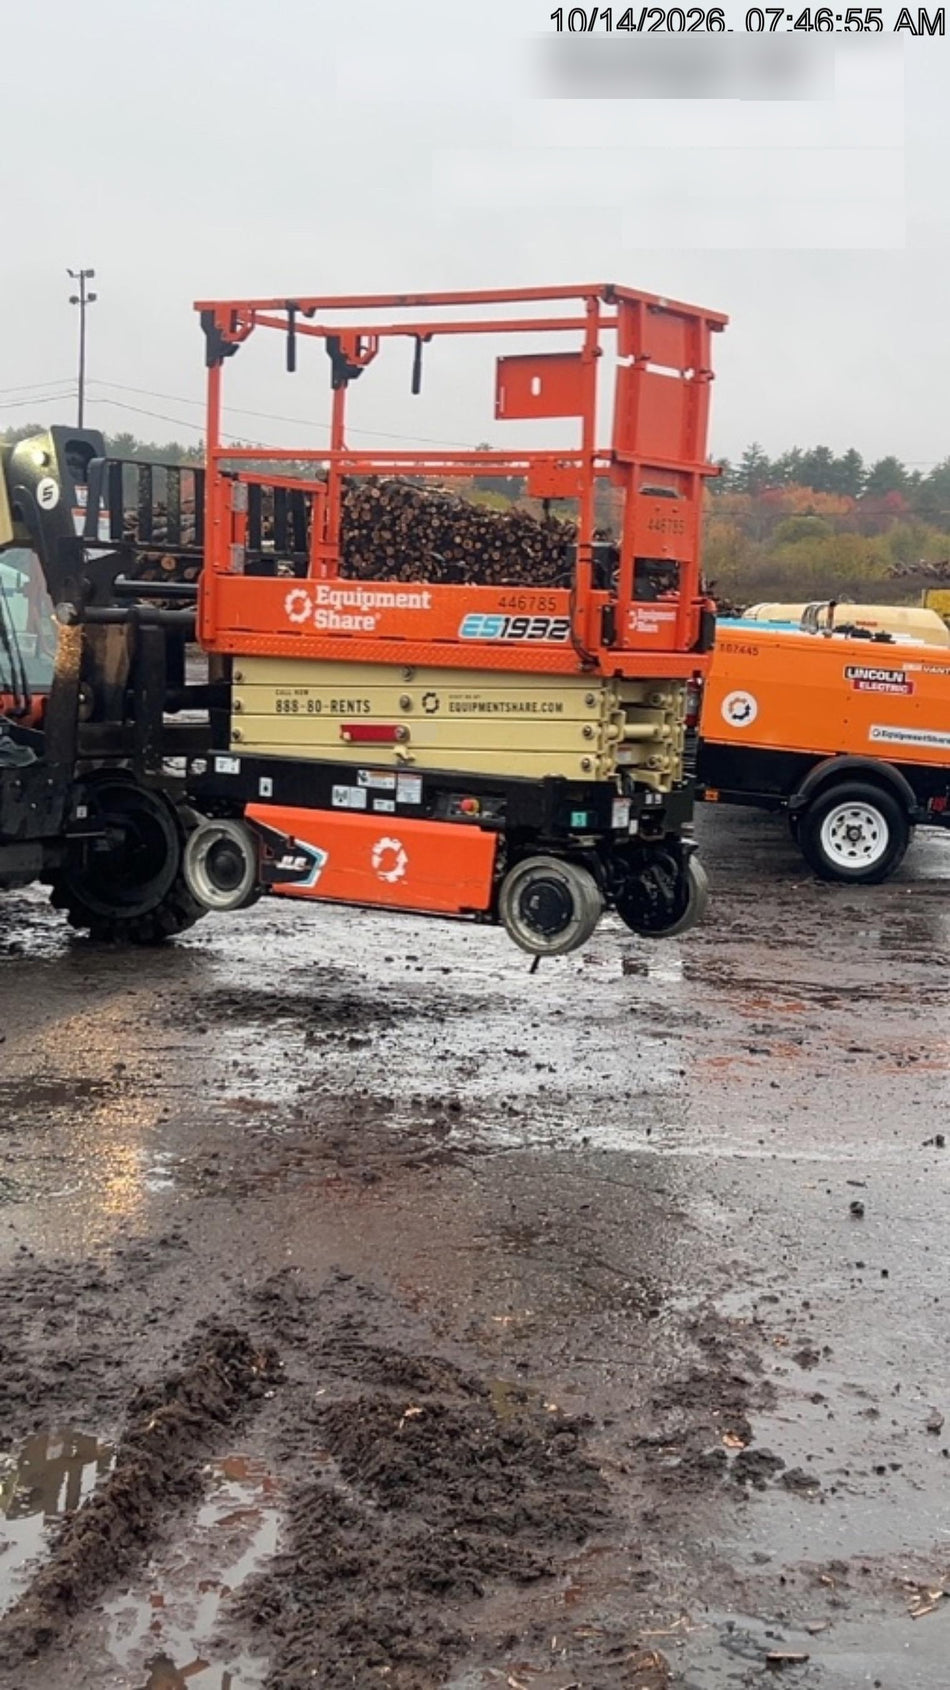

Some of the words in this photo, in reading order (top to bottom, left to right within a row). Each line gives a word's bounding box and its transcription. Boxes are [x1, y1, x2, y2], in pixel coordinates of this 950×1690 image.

[315, 585, 432, 611] Equipment
[498, 596, 557, 612] 446785
[314, 609, 376, 631] Share
[460, 615, 570, 640] ES1932
[847, 667, 904, 683] LINCOLN
[859, 681, 909, 693] ELECTRIC
[275, 699, 370, 713] 888-80-RENTS
[449, 702, 564, 713] EQUIPMENTSHARE.COM
